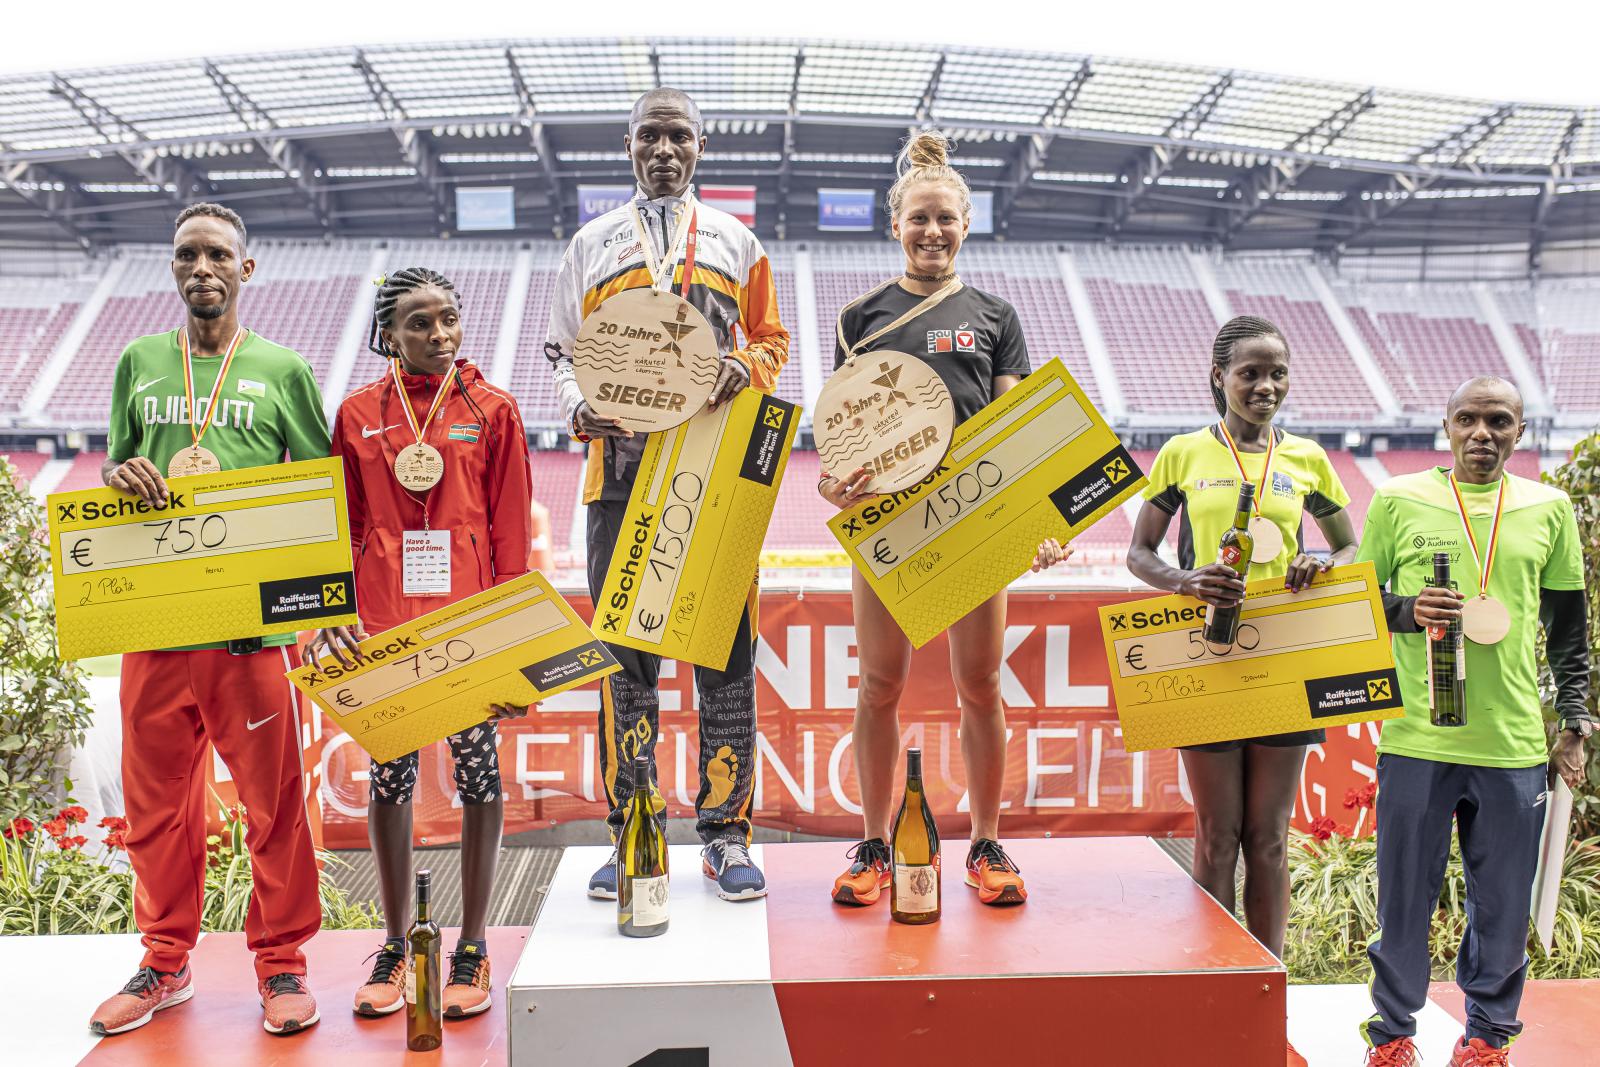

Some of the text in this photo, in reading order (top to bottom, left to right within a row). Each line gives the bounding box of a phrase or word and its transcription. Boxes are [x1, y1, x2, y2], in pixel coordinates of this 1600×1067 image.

[596, 322, 662, 343] 20 Jahre
[595, 383, 687, 412] SIEGER
[825, 392, 882, 431] 20 Jahre
[143, 395, 255, 430] DJIBOUTI
[757, 429, 773, 466] Raiffeisen
[761, 432, 779, 476] Meine Bank
[861, 425, 940, 478] SIEGER
[1070, 482, 1112, 515] Meine Bank
[1072, 476, 1107, 504] Raiffeisen
[82, 491, 186, 521] Scheck
[872, 537, 899, 565] €
[923, 460, 1003, 529] 1500
[70, 514, 227, 567] € 750
[405, 545, 425, 553] good
[638, 471, 703, 633] € 1500
[611, 511, 653, 611] Scheck
[896, 551, 944, 595] 1 Platz
[79, 577, 135, 606] 2 Platz
[279, 592, 321, 606] Raiffeisen
[271, 599, 321, 614] Meine Bank
[1131, 604, 1207, 629] Schec
[323, 636, 418, 679] Scheck
[544, 661, 579, 677] Raiffeisen
[1125, 644, 1147, 670] €
[336, 639, 475, 708] € 750
[541, 666, 583, 684] Meine Bank
[1136, 675, 1206, 704] 3 Platz
[1319, 696, 1367, 709] Meine Bank
[1325, 688, 1366, 700] Raiffeisen
[361, 719, 372, 731] 2
